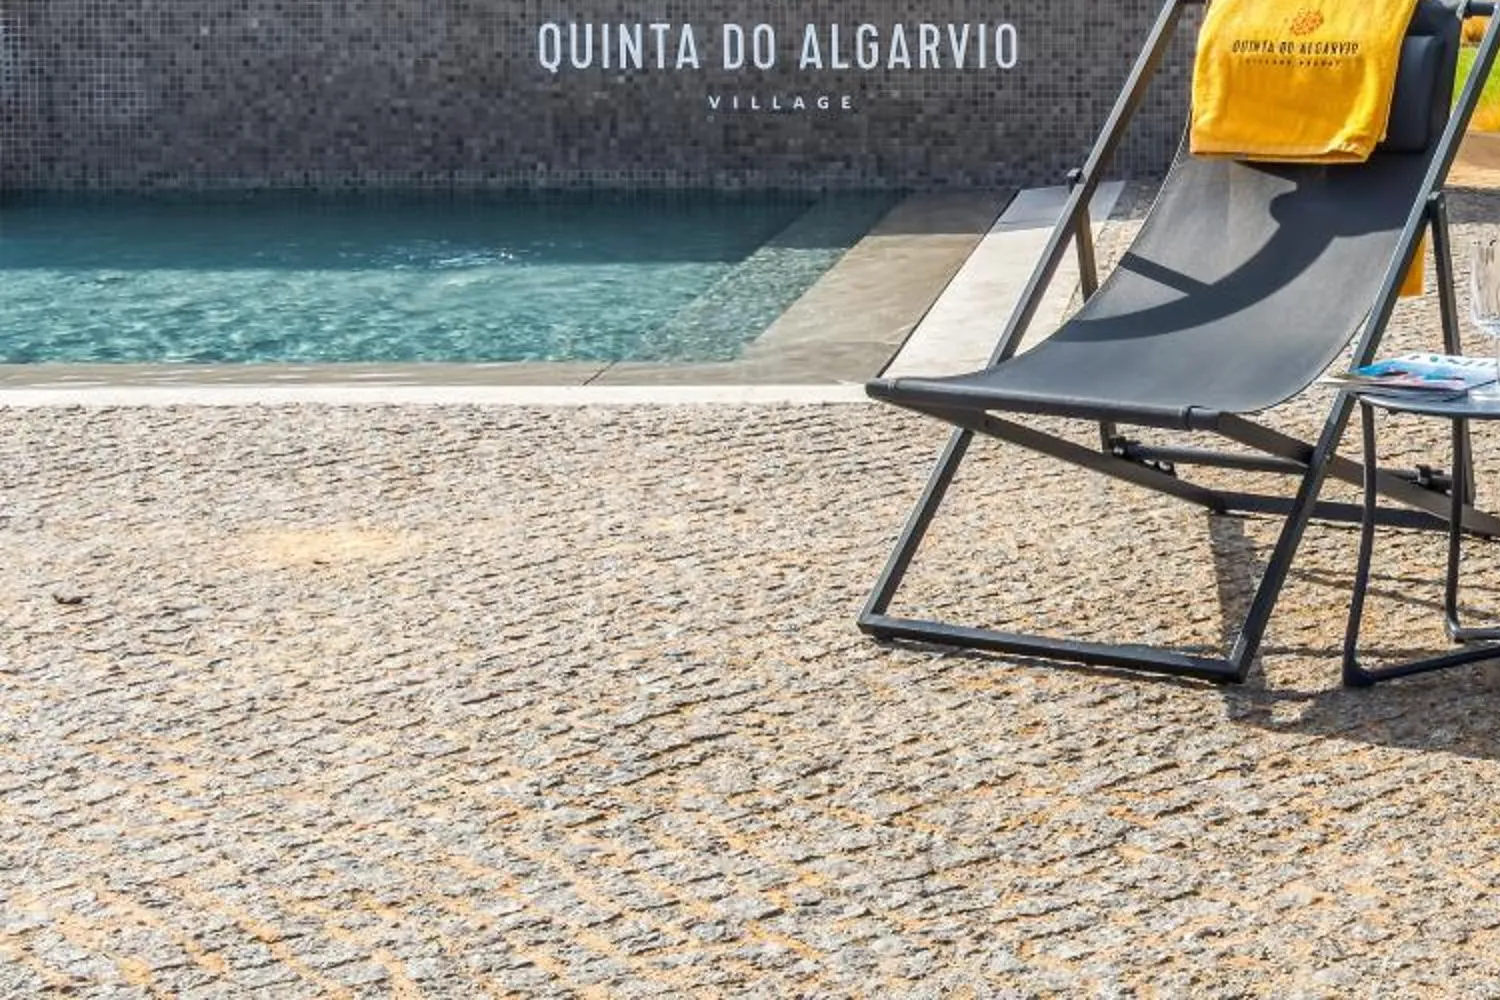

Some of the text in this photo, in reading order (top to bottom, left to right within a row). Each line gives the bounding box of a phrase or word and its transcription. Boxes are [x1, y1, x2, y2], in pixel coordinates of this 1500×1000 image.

[538, 22, 1018, 73] QUINTA DO ALGARVIO
[708, 95, 851, 110] VILLAGE
